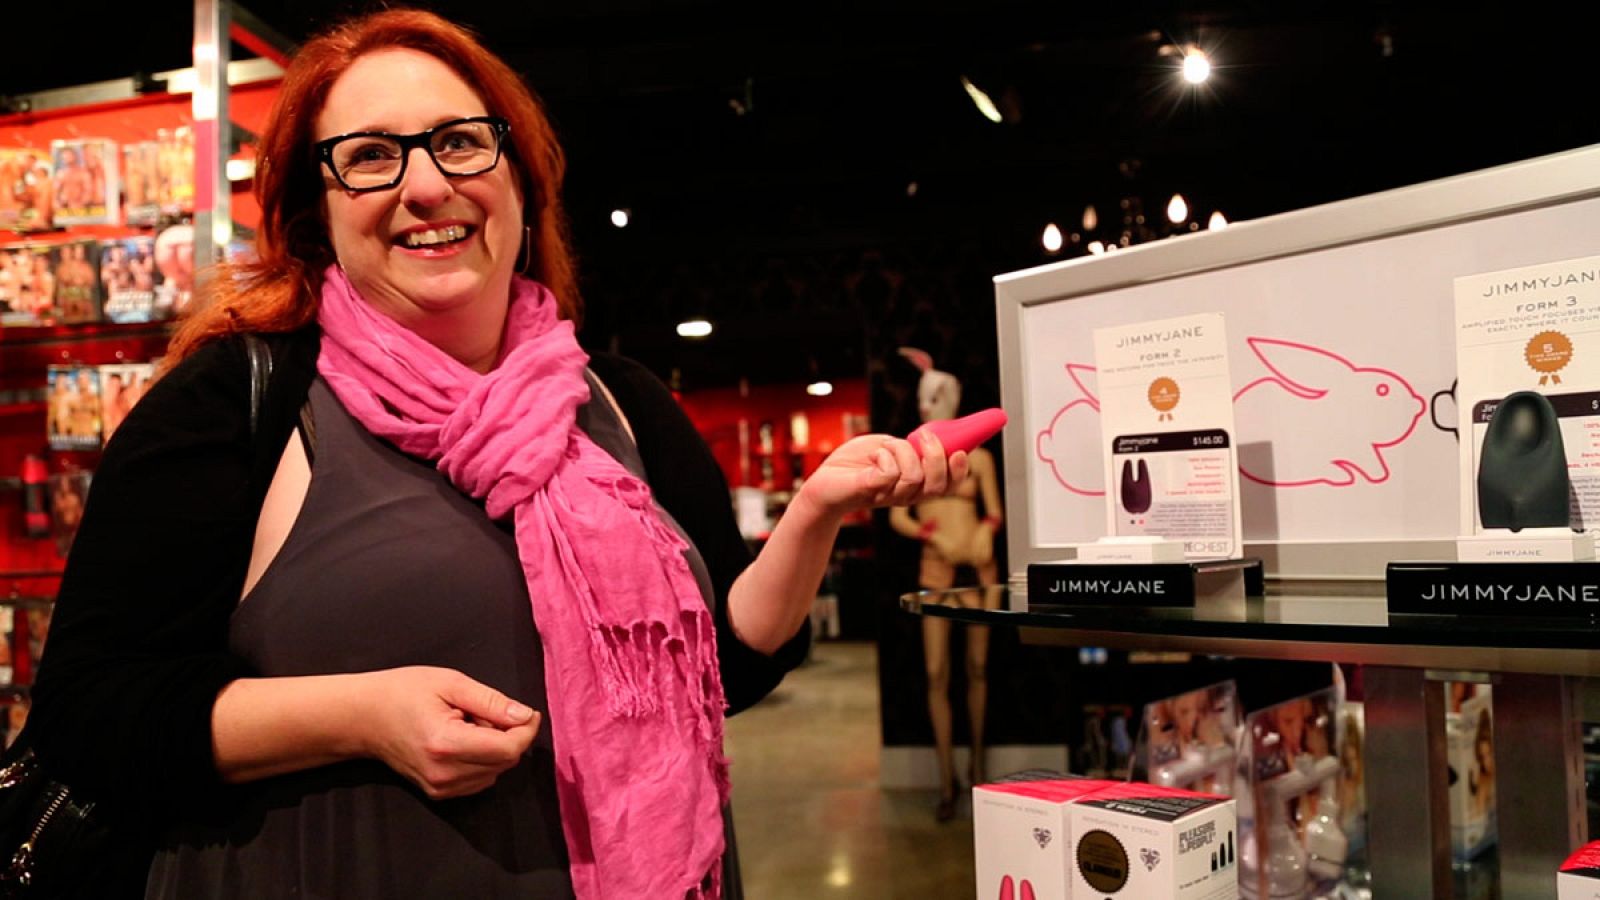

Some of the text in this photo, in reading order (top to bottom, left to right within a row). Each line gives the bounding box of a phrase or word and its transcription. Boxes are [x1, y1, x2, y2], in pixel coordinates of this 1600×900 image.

[1516, 295, 1577, 313] FORM 3
[1509, 313, 1539, 322] TOUCH
[1116, 326, 1203, 349] JIMMYJANE
[1140, 348, 1182, 362] FORM 2
[1193, 435, 1224, 446] $145.00
[1487, 549, 1542, 557] JIMMYJANE
[1049, 579, 1166, 595] JIMMYJANE
[1421, 584, 1600, 602] JIMMYJANE
